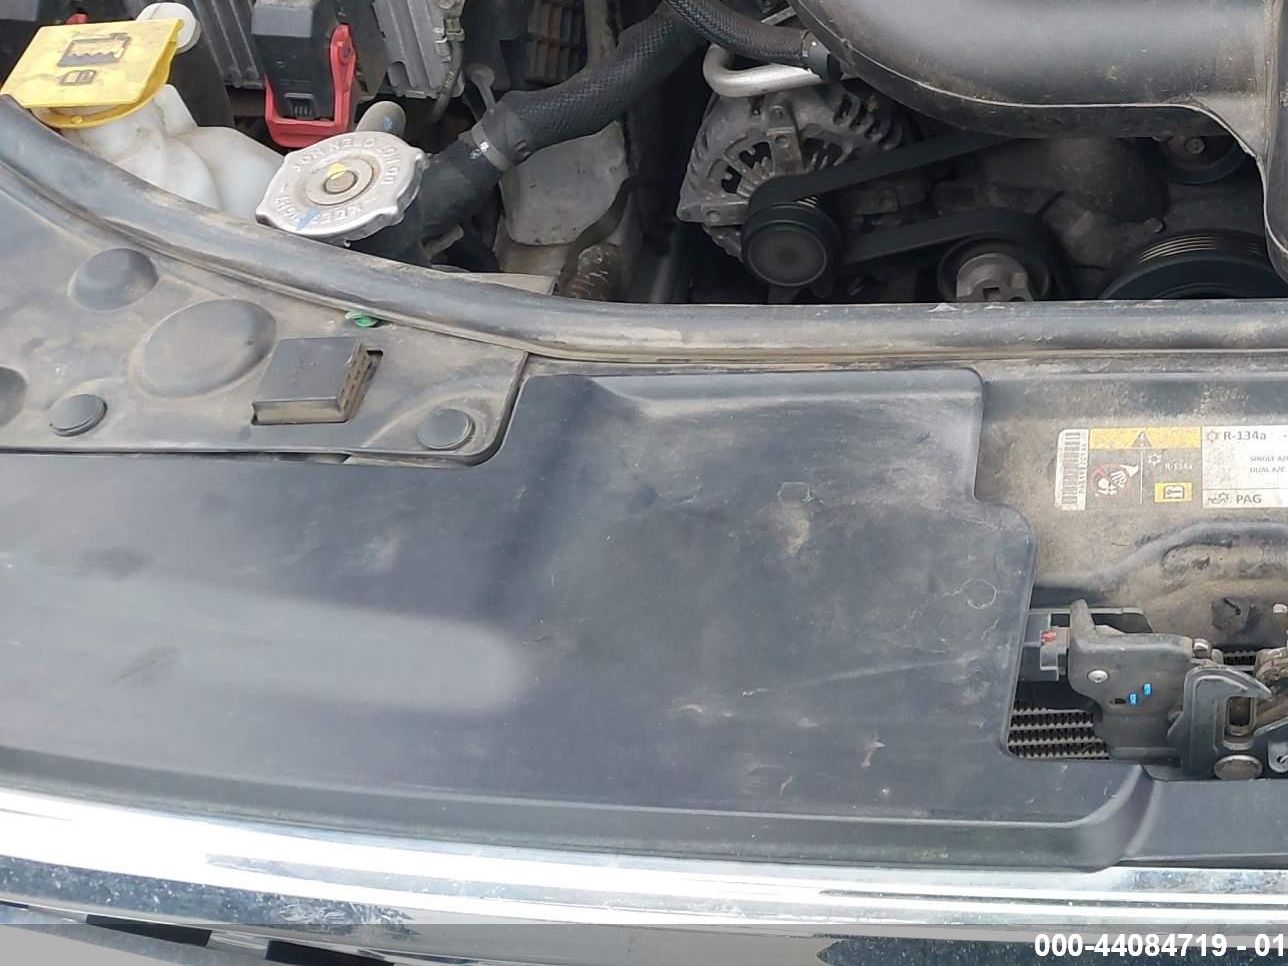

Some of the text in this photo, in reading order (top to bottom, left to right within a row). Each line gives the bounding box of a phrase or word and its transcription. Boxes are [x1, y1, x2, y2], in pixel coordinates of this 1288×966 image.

[1223, 430, 1267, 441] R-134a
[1250, 454, 1274, 462] SINGLE
[1272, 465, 1286, 473] A/C
[1236, 493, 1263, 505] PAG
